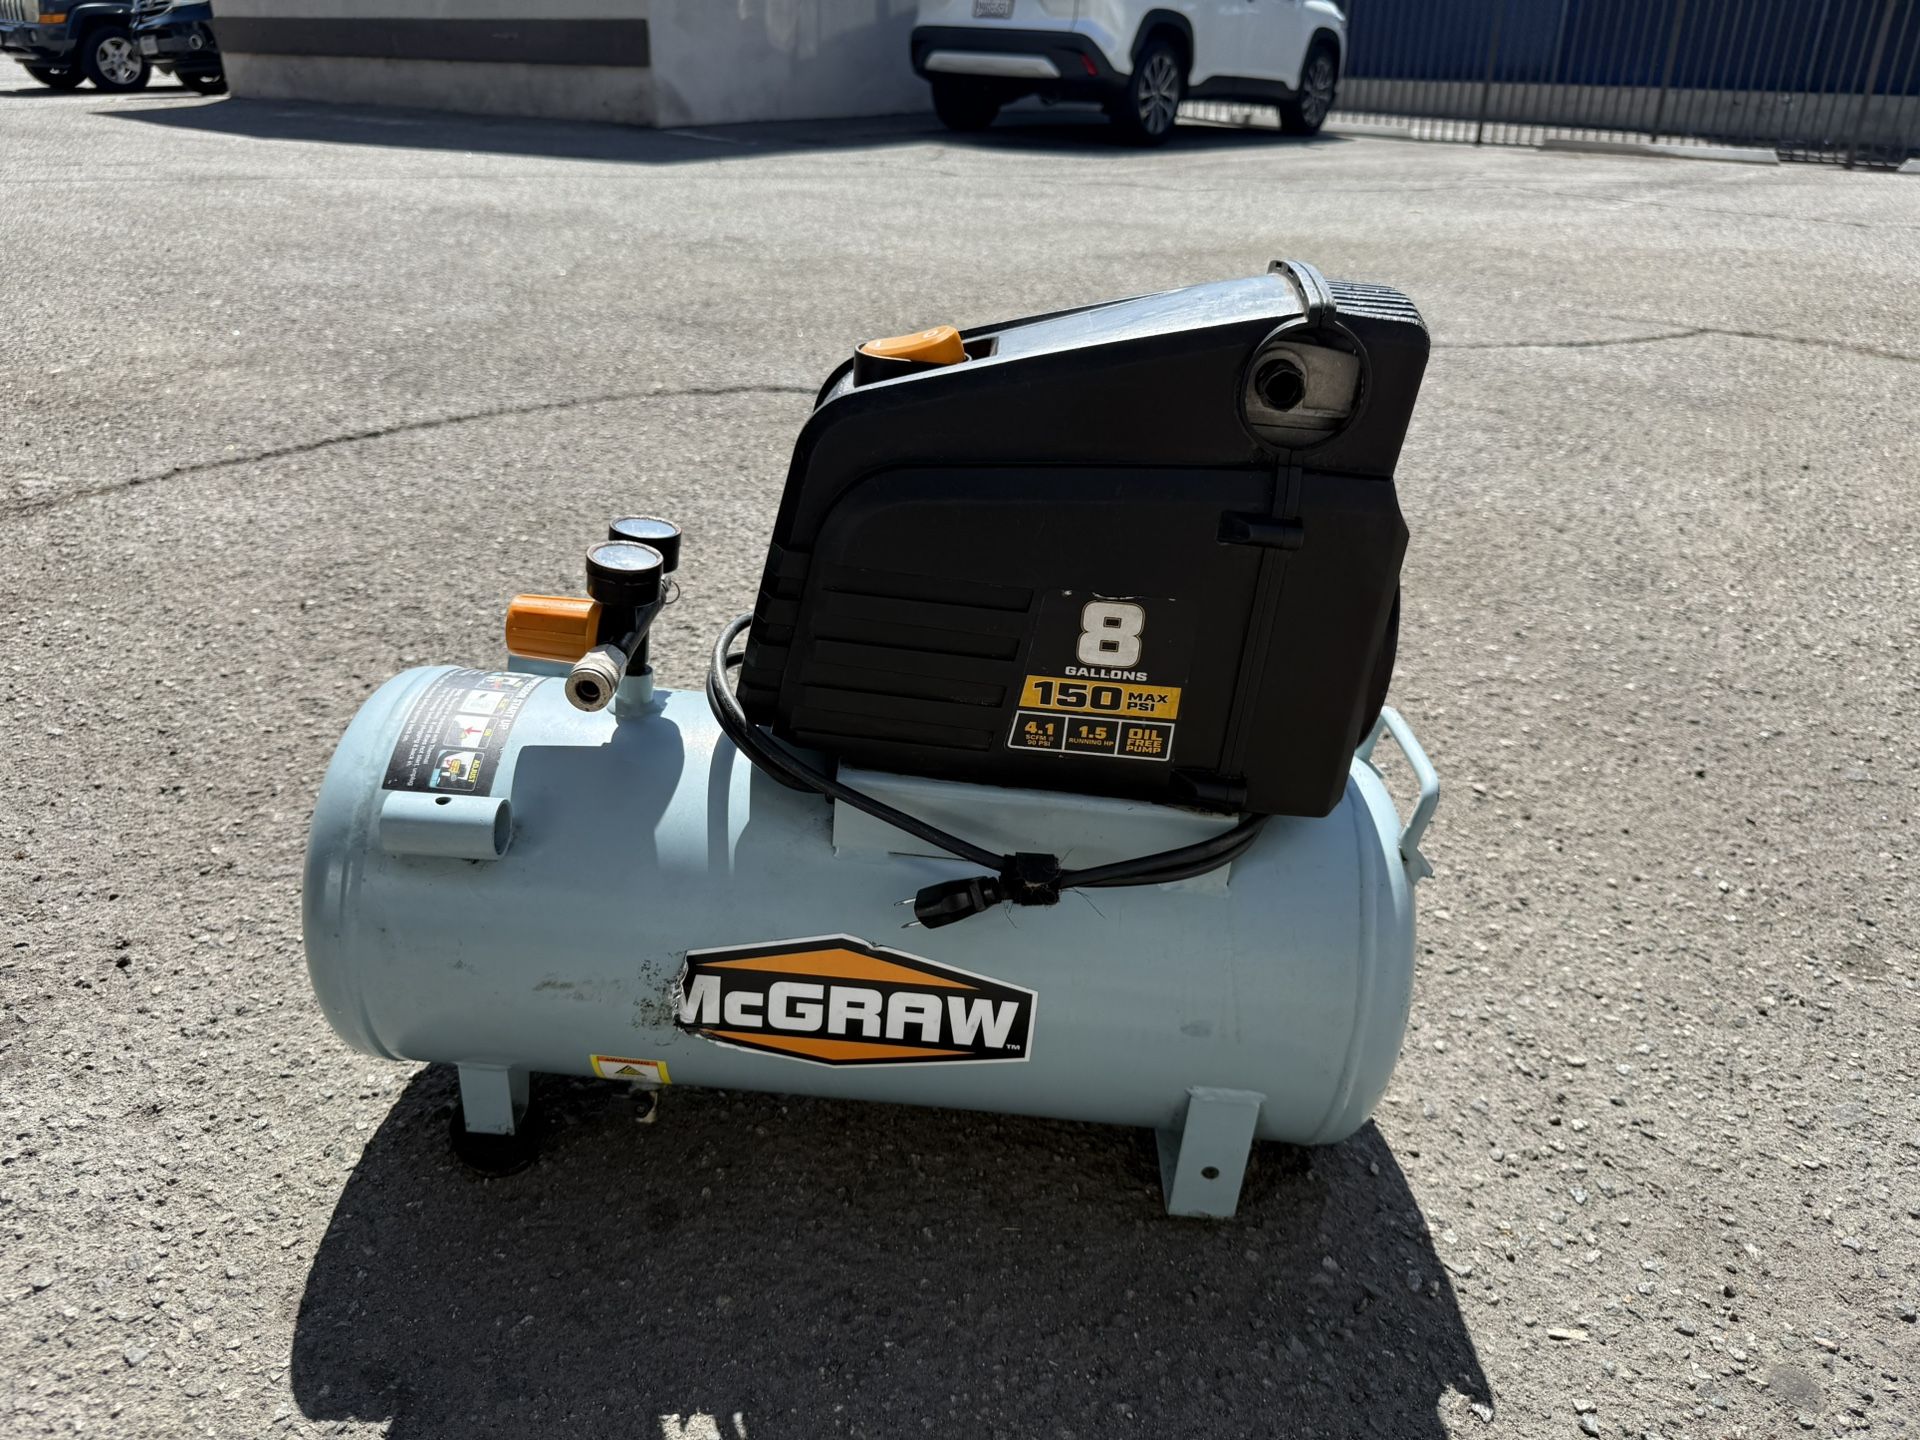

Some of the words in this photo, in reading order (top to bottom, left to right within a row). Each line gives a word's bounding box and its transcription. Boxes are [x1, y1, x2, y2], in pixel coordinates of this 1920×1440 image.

[1077, 600, 1145, 668] 8
[1065, 666, 1148, 681] GALLONS
[1033, 680, 1123, 711] 150
[1128, 692, 1168, 703] MAX
[1127, 702, 1155, 712] PSI
[497, 719, 511, 729] UP
[1024, 721, 1055, 735] 4.1
[1079, 725, 1107, 739] 1.5
[1128, 728, 1163, 741] OIL
[1068, 737, 1102, 746] RUNNING
[1126, 738, 1162, 748] FREE
[1126, 746, 1161, 754] PUMP
[407, 767, 418, 785] unplug
[467, 759, 480, 782] ADJUST
[680, 974, 1019, 1049] McGRAW
